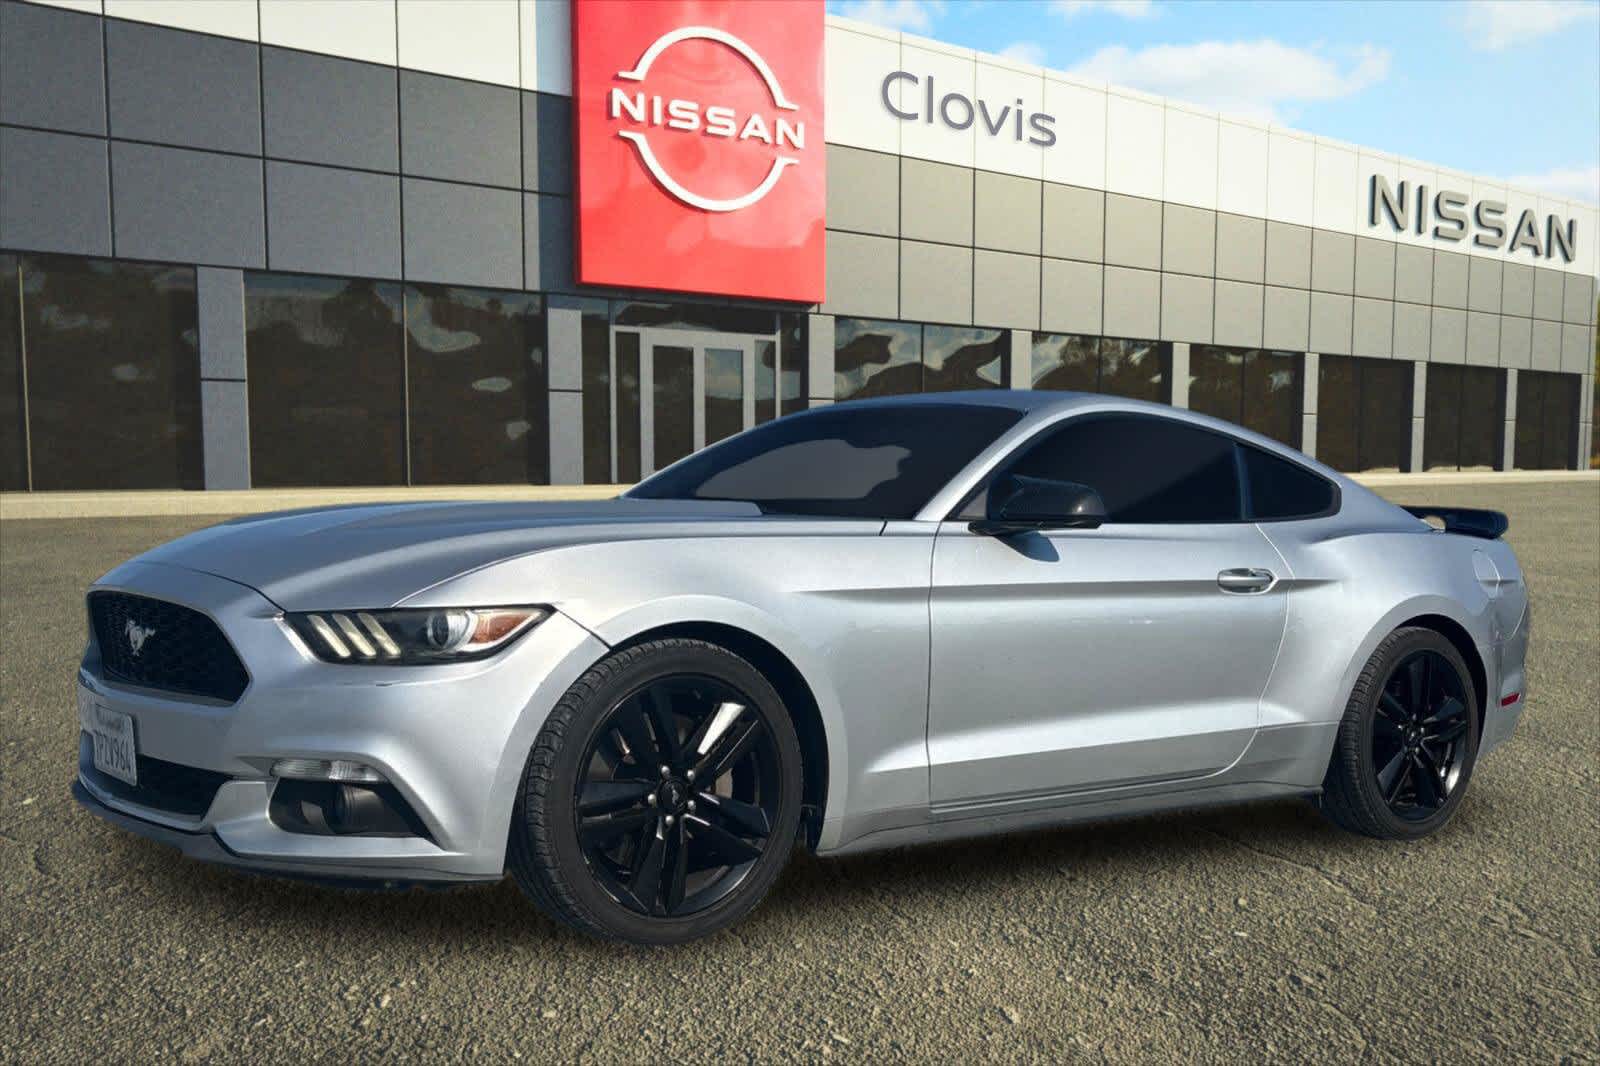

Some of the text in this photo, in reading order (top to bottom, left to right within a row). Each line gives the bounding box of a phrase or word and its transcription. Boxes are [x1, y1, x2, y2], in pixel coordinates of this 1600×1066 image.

[610, 88, 806, 150] NISSAN
[881, 71, 1057, 147] Clovis
[1369, 174, 1577, 263] NISSAN
